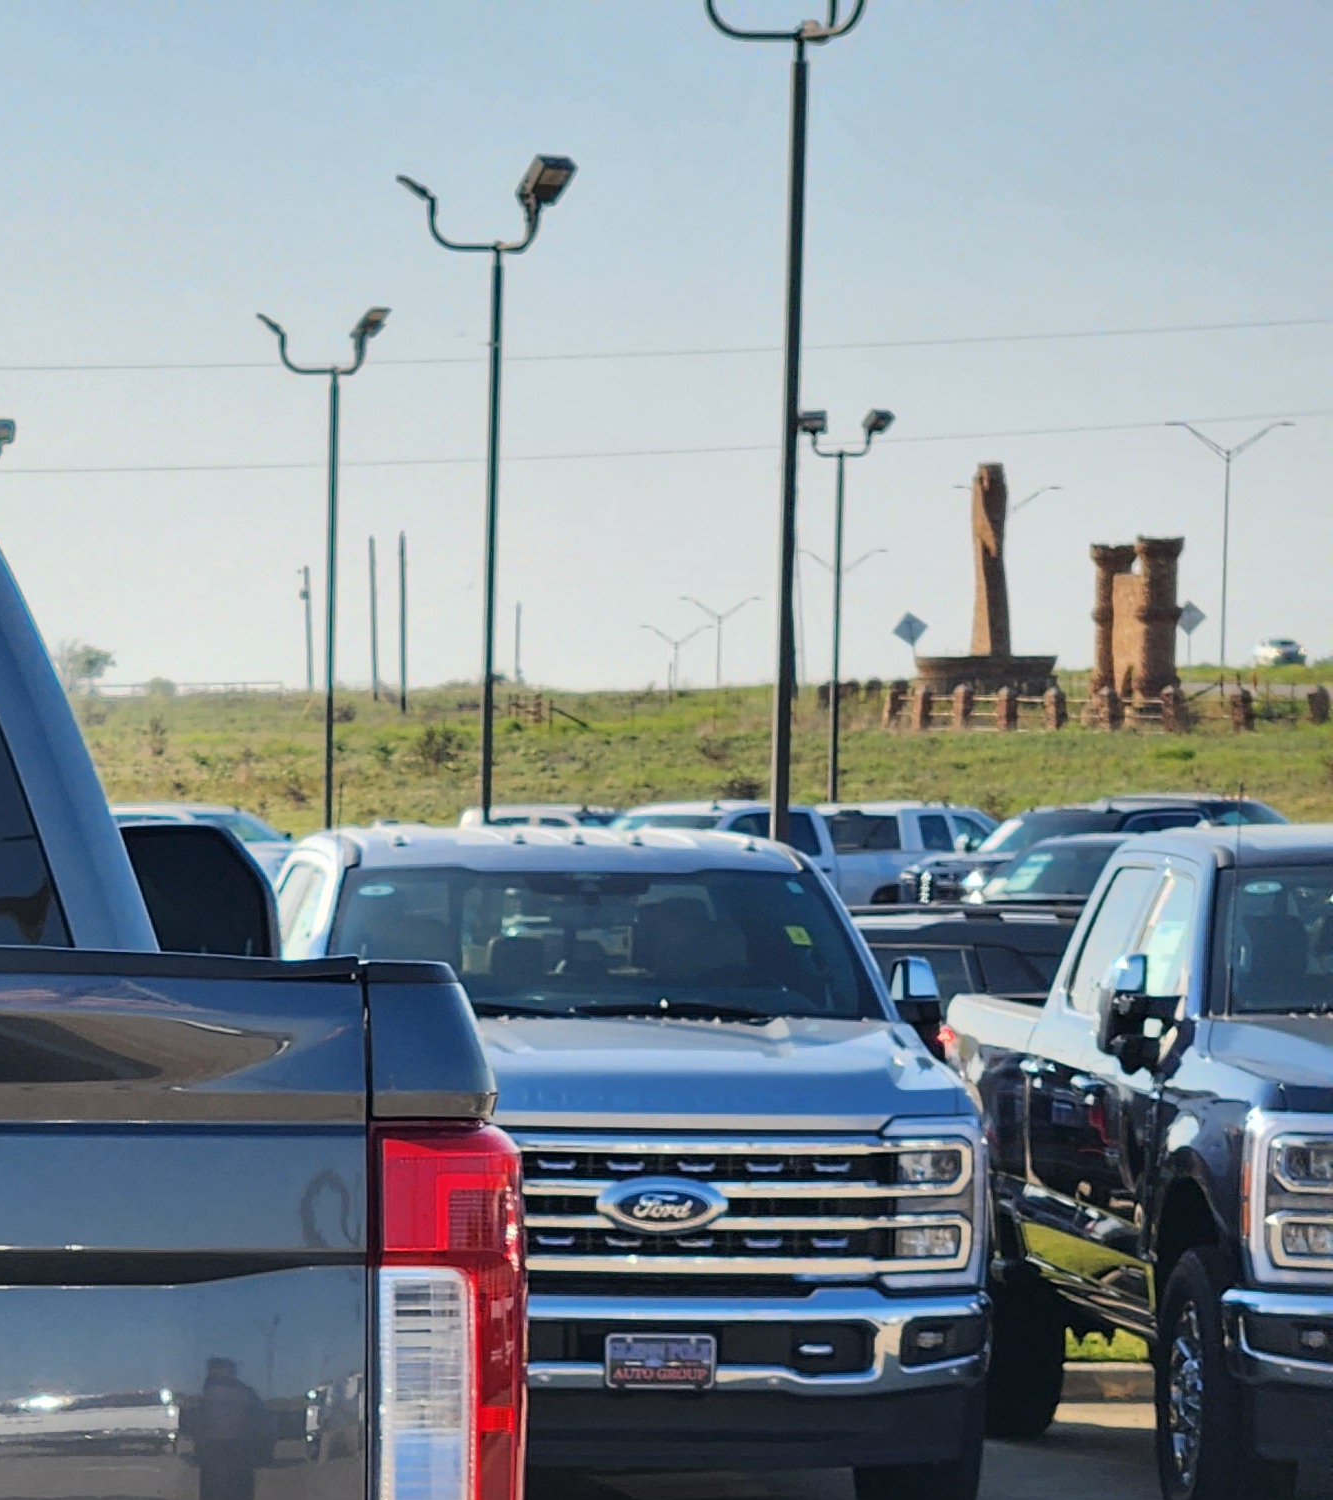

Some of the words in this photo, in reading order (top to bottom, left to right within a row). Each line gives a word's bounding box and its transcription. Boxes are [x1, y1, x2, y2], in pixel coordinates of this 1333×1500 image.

[633, 1193, 693, 1219] Ford
[614, 1367, 654, 1380] AUTO
[656, 1367, 709, 1380] GROUP
